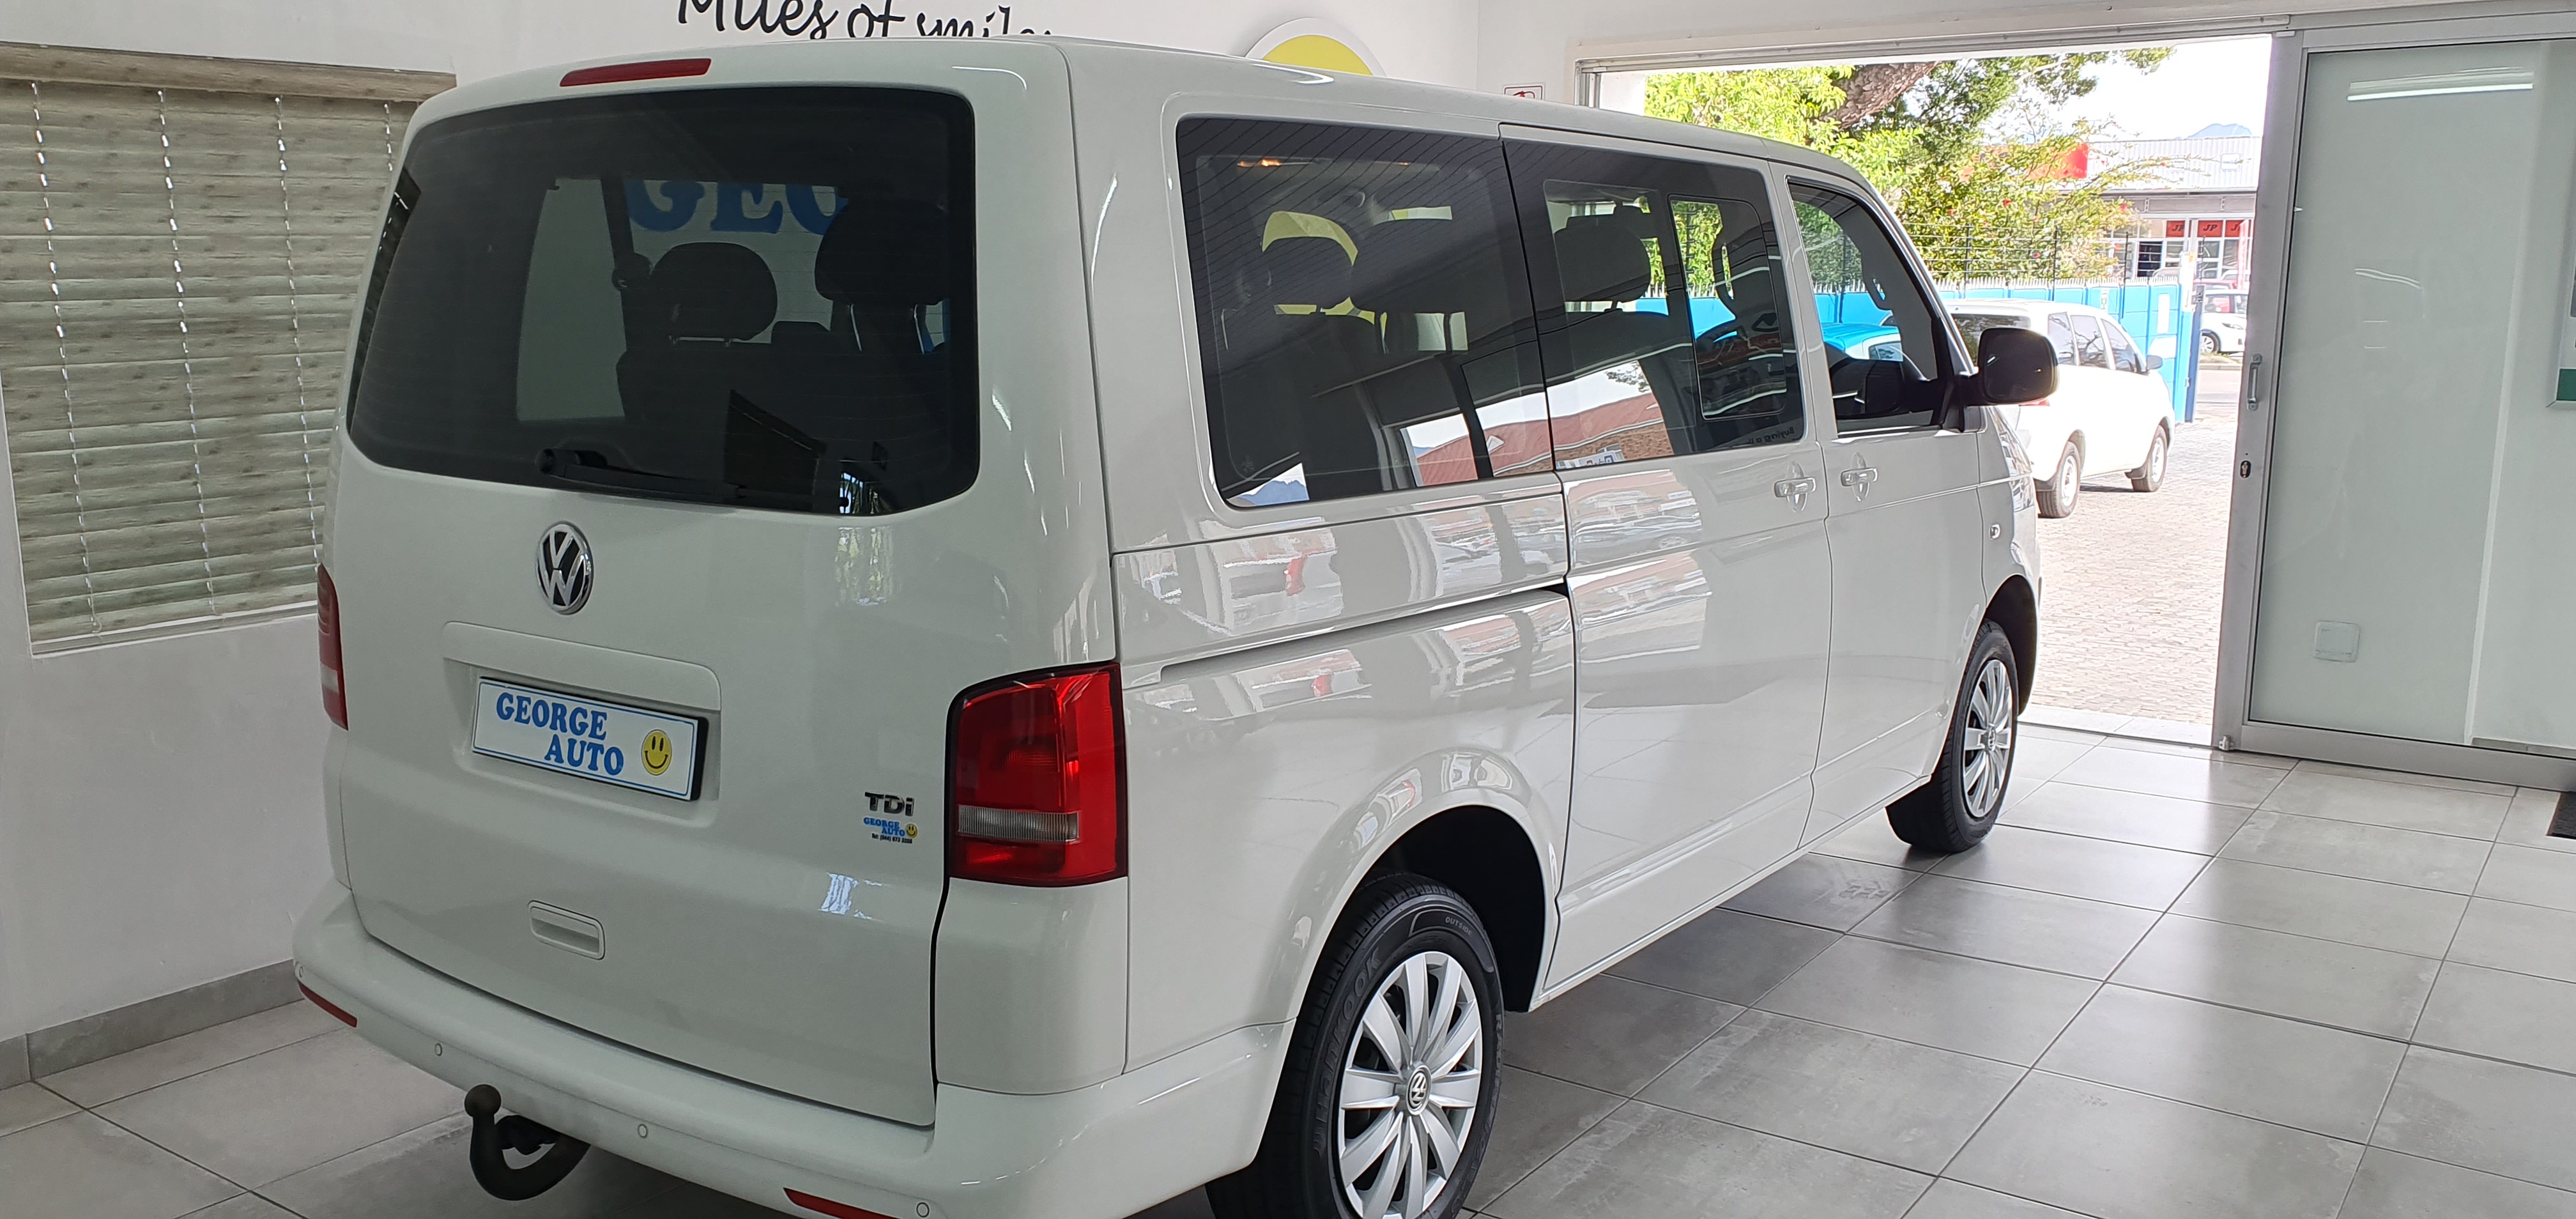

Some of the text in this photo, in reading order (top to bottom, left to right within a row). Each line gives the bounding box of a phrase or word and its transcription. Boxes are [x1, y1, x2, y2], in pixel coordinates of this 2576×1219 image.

[496, 692, 608, 741] GEORGE
[544, 734, 624, 776] AUTO
[862, 817, 900, 830] GEORGE
[881, 827, 905, 837] AUTO
